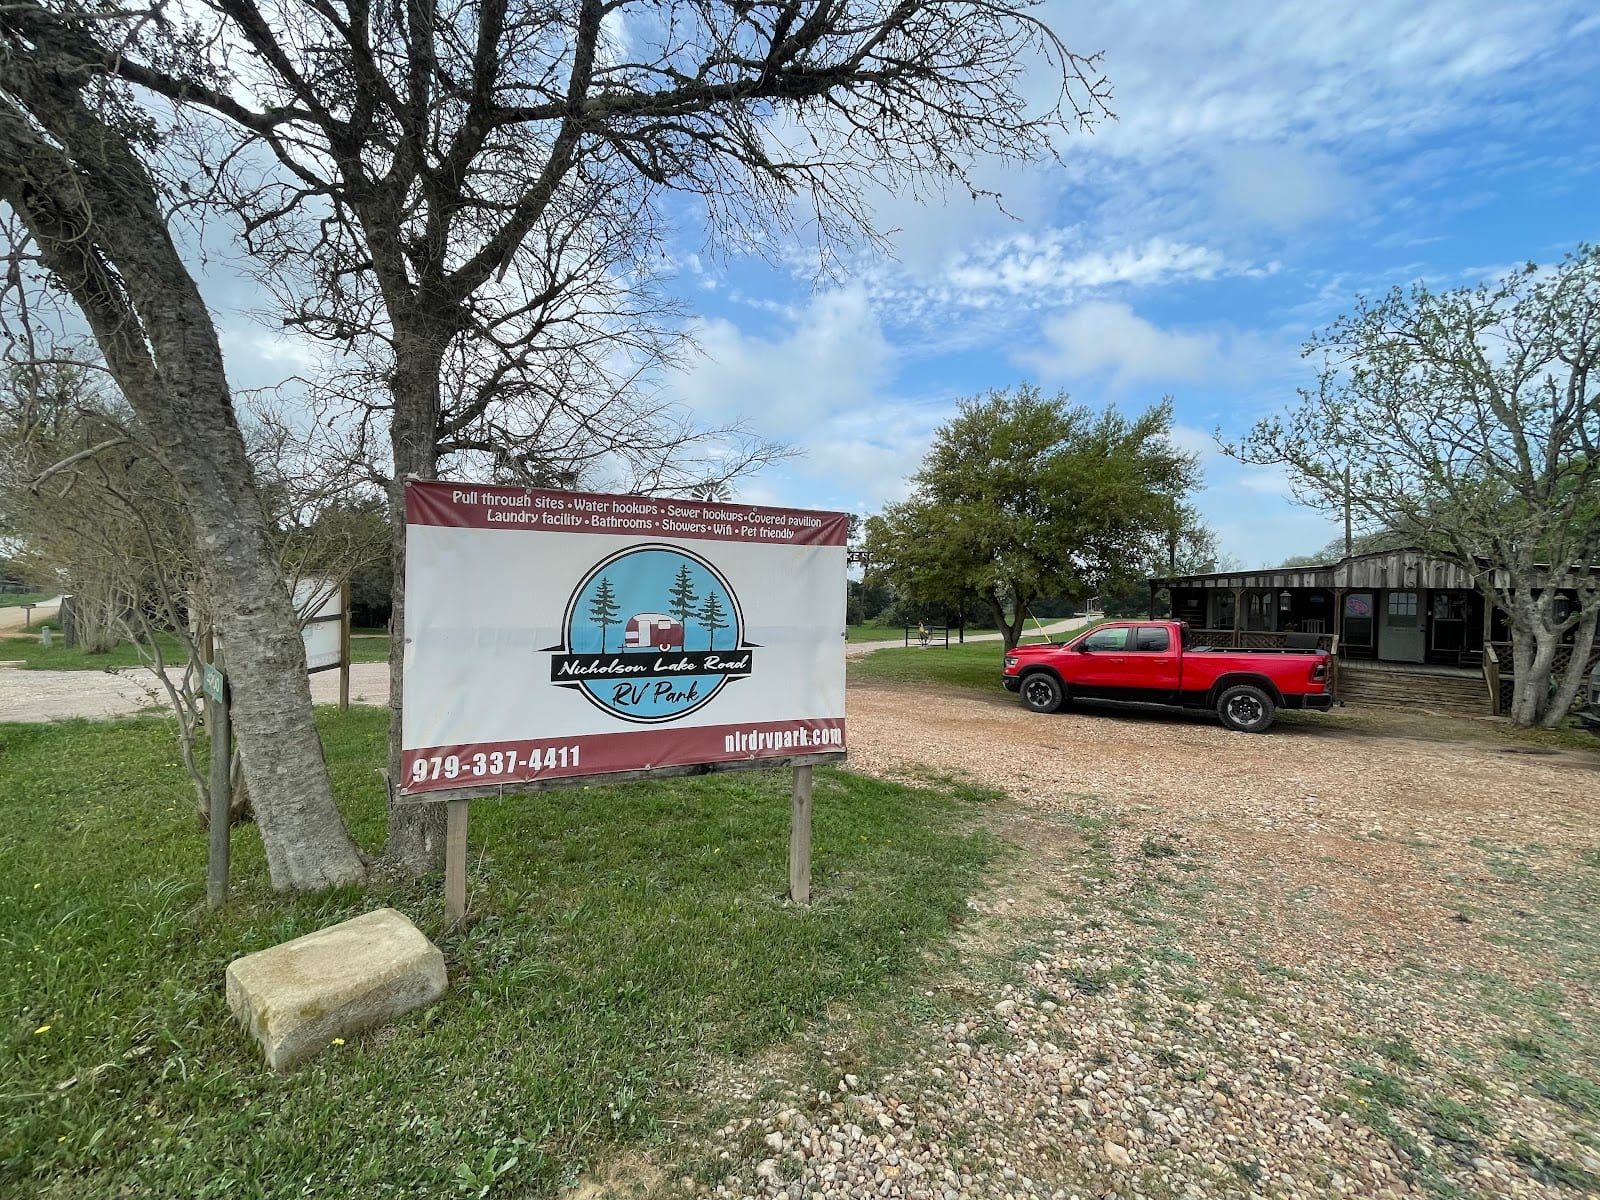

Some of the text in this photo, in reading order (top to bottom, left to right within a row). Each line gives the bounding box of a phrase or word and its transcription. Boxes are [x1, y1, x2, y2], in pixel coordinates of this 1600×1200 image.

[452, 490, 822, 528] Pull through sites Water hookups Sewer hookups Covered pavilion
[487, 509, 794, 539] Laundry facility Bathrooms Showers Wifi Pet friendly
[557, 653, 750, 676] Nicholson Lake Road
[612, 680, 700, 706] RV Park
[725, 726, 842, 753] nlrdrvpark.com
[412, 745, 580, 783] 979-337-4411
